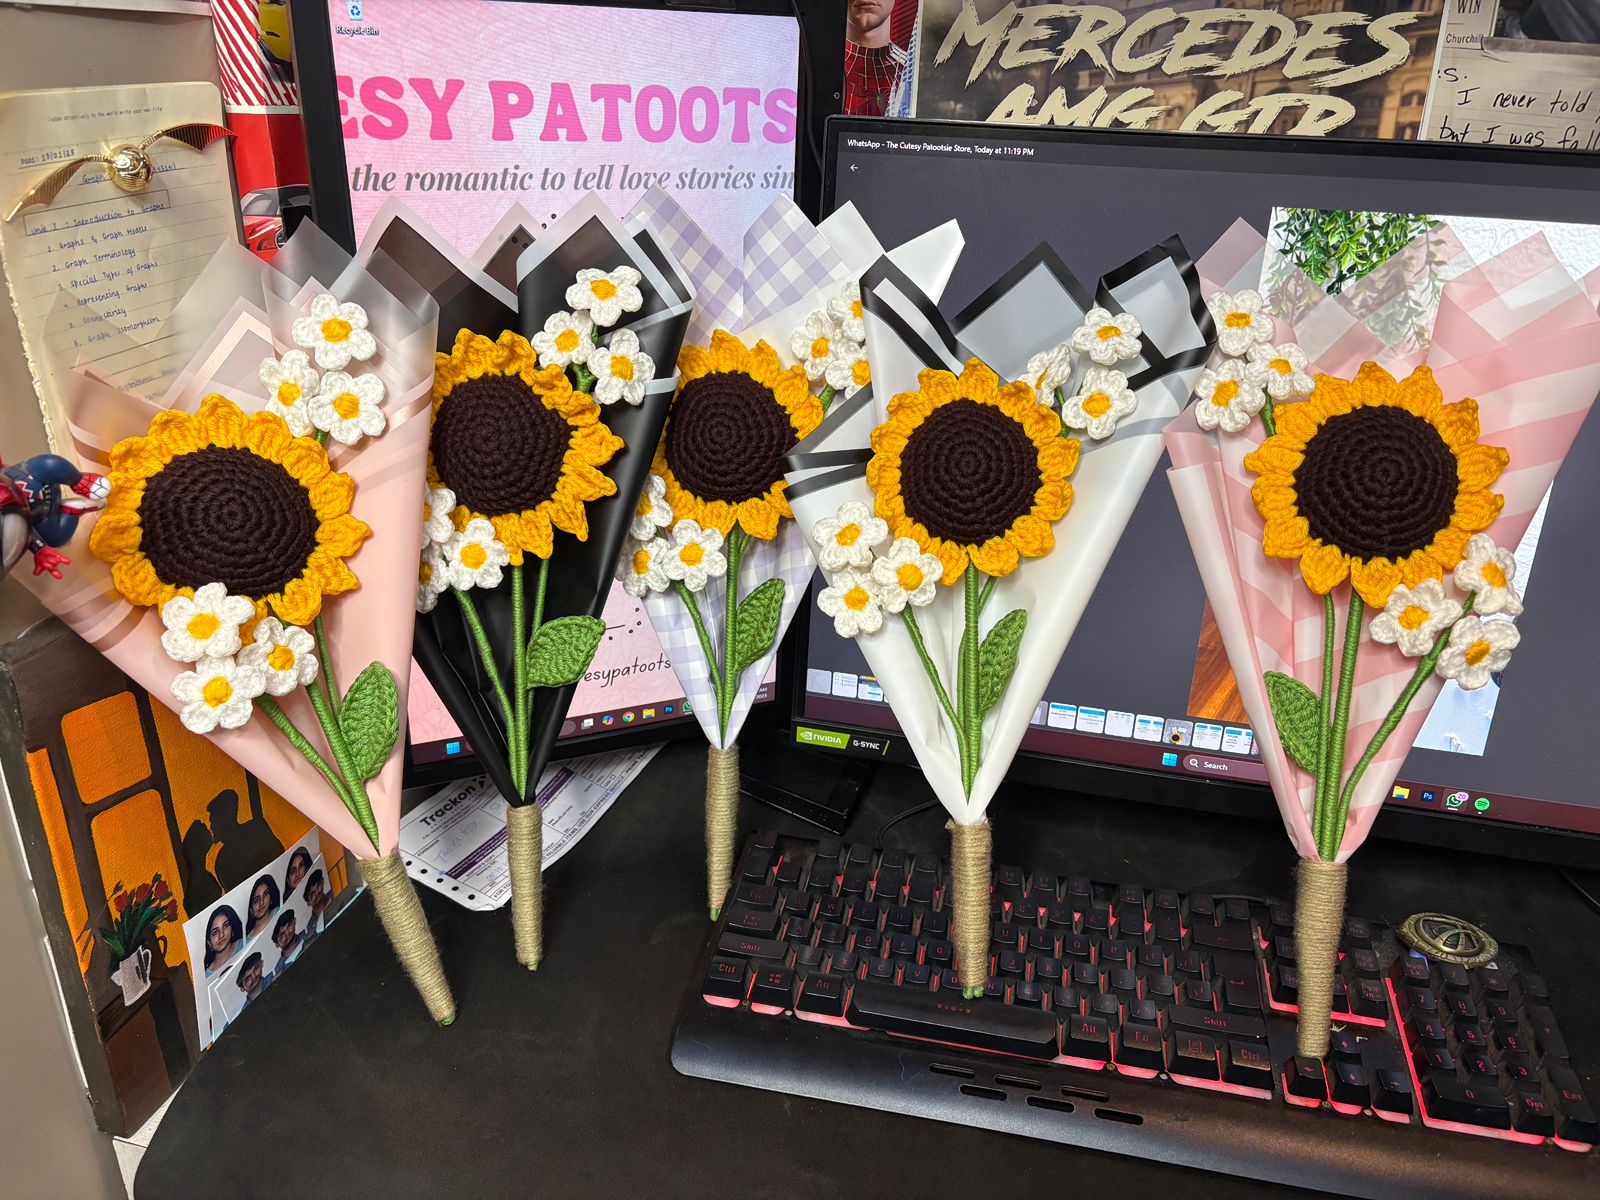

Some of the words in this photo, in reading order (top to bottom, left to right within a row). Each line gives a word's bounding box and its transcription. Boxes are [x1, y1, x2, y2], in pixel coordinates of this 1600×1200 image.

[336, 26, 365, 37] Recycle
[366, 27, 380, 36] Bin
[934, 0, 1421, 88] MERCEDES
[1492, 92, 1537, 109] never
[1550, 89, 1593, 114] told
[1440, 115, 1470, 144] but
[1510, 131, 1545, 147] was
[847, 139, 881, 149] WhatsApp
[886, 141, 898, 149] The
[899, 142, 921, 151] Cutesy
[922, 143, 952, 152] Patootsie
[953, 145, 973, 154] Store,
[974, 146, 993, 155] Today
[1003, 147, 1021, 155] 11:19
[1022, 148, 1034, 156] PM
[352, 163, 396, 193] the
[404, 164, 534, 192] romantic
[541, 168, 566, 192] to
[573, 164, 613, 191] tell
[620, 164, 671, 191] love
[676, 166, 755, 191] stories
[73, 211, 122, 227] Introduction
[127, 208, 135, 216] to
[141, 203, 164, 214] Graphs
[58, 239, 85, 250] Graphs
[102, 231, 123, 241] Graph
[127, 225, 148, 235] Models
[65, 258, 88, 269] Graph
[94, 248, 136, 262] Terminology
[71, 275, 98, 288] Special
[102, 271, 120, 281] Types
[127, 269, 134, 277] of
[137, 262, 158, 272] Graphs
[77, 289, 120, 306] Representing
[126, 282, 148, 293] Graphs
[583, 652, 671, 688] esypatoots
[813, 733, 842, 744] NVIDIA
[852, 740, 880, 750] G-SYNC
[1203, 761, 1228, 771] Search
[1423, 792, 1433, 800] Ps
[419, 785, 476, 826] Trackon
[493, 888, 504, 899] FOR
[719, 962, 735, 974] Ctrl
[1135, 1031, 1148, 1042] Fn
[1467, 1030, 1476, 1040] 5
[1240, 1049, 1260, 1060] Ctrl
[1476, 1060, 1486, 1069] 2
[1518, 1066, 1528, 1077] 3
